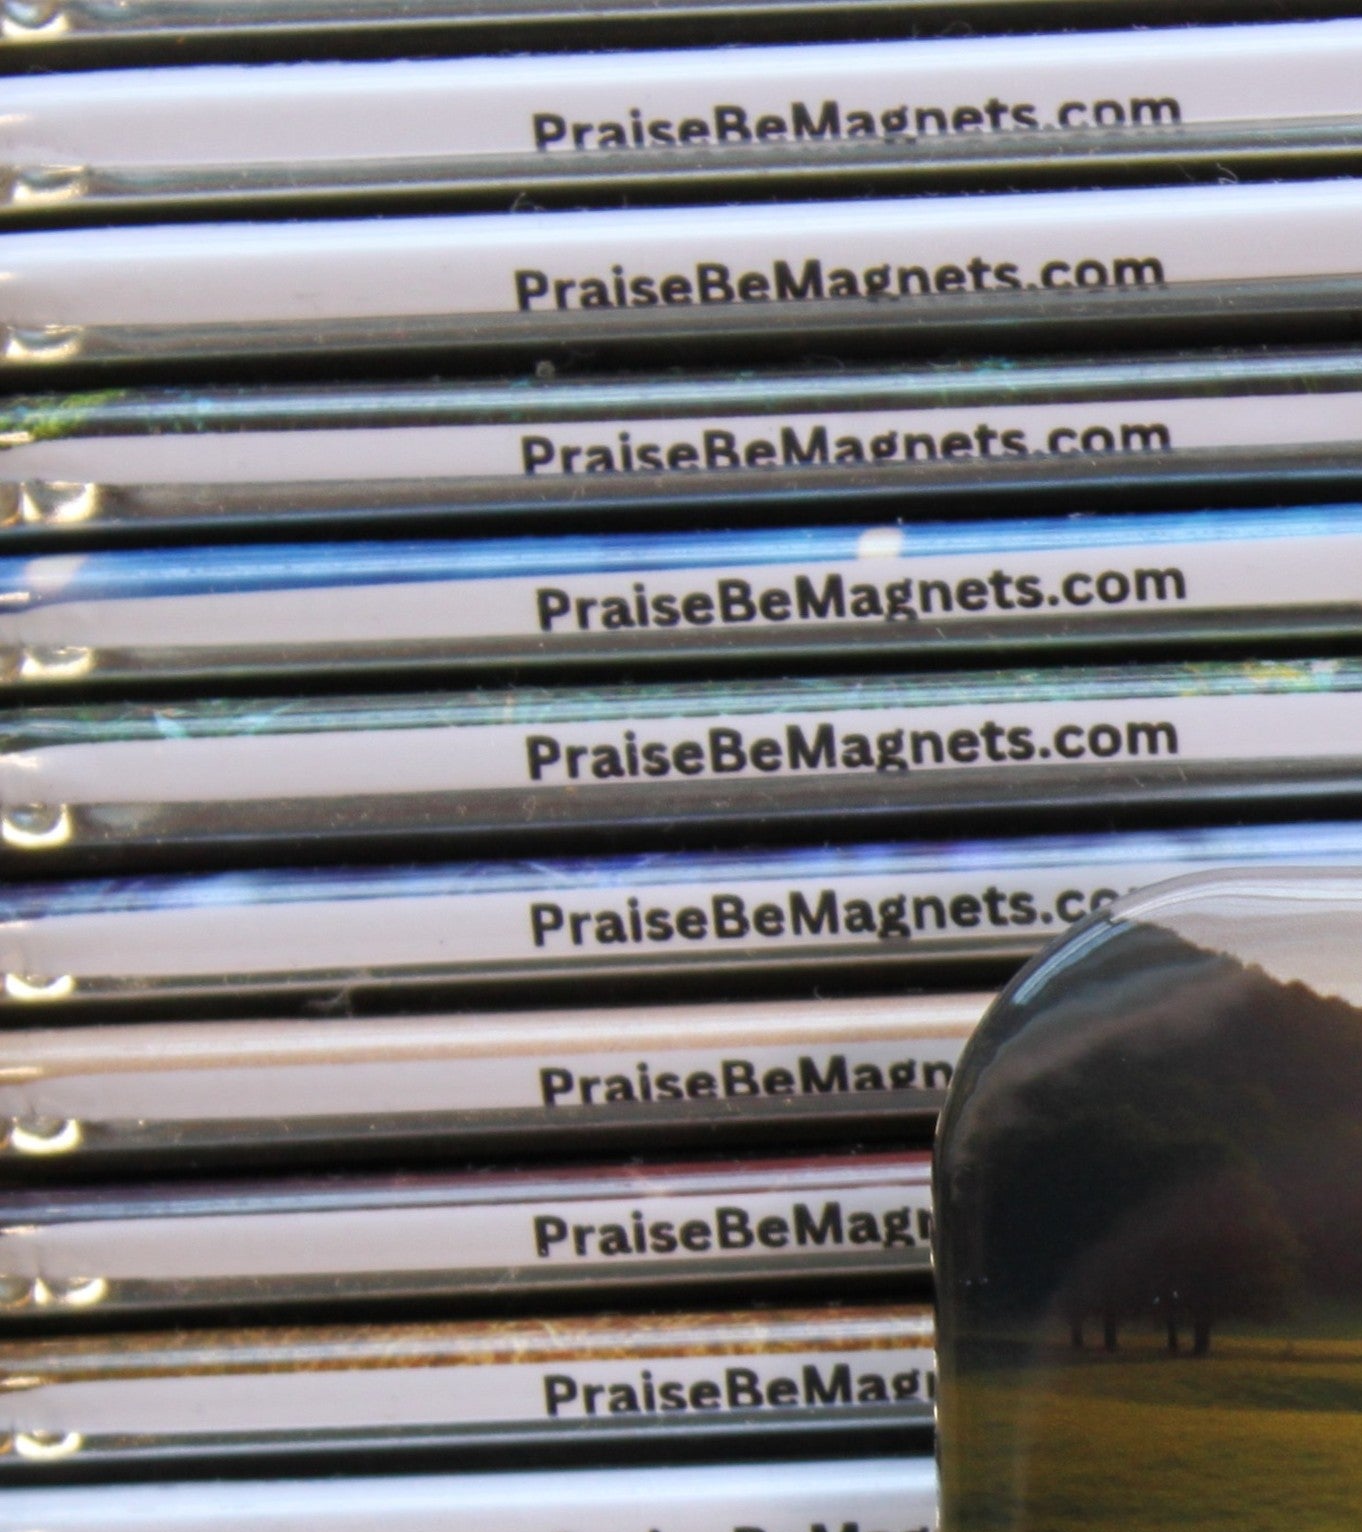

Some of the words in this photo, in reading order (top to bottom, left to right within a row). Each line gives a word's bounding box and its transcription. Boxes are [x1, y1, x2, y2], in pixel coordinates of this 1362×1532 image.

[514, 256, 1165, 311] PraiseBeMagnets.com
[536, 566, 1187, 632] PraiseBeMagnets.com
[526, 720, 1178, 780] PraiseBeMagnets.com
[530, 886, 1139, 947] PraiseBeMagnets.co
[540, 1055, 952, 1106] PraiseBeMagn
[533, 1203, 933, 1257] PraiseBeMag
[543, 1364, 935, 1417] PraiseBeMag
